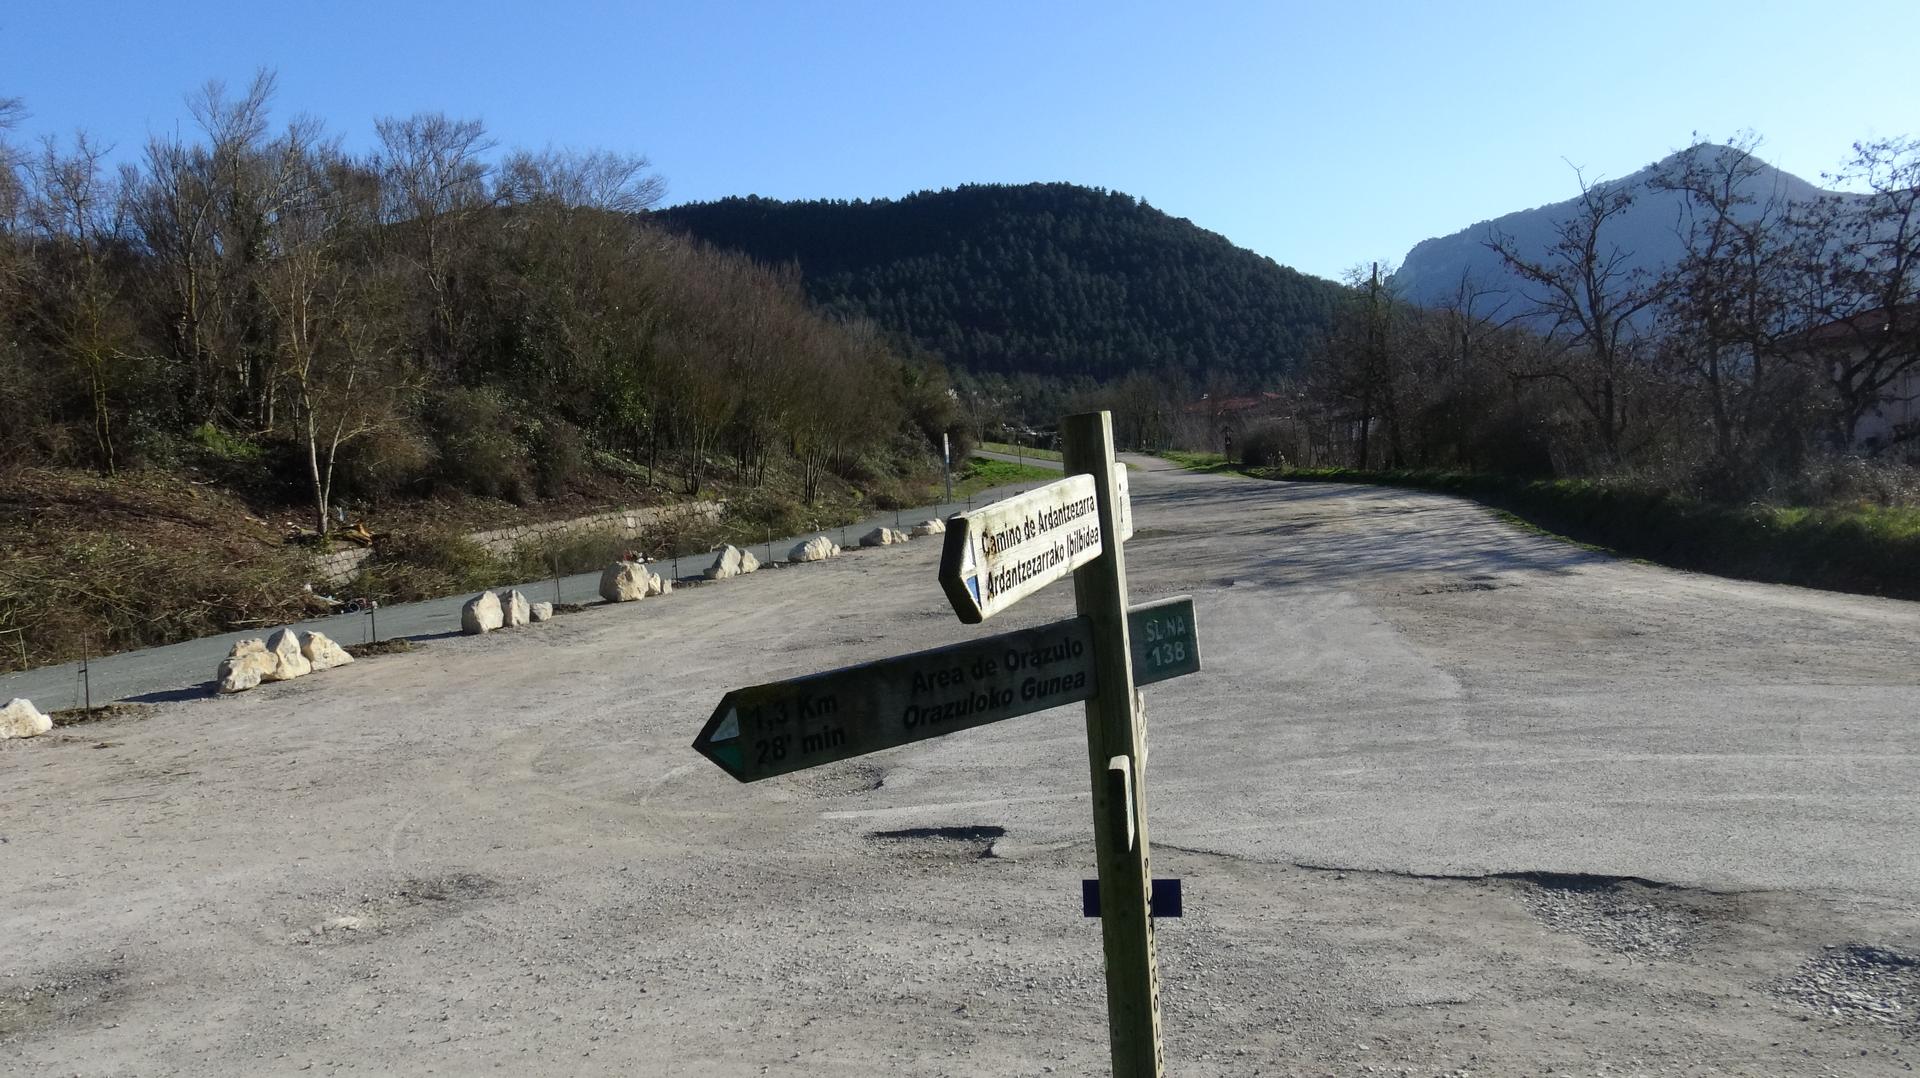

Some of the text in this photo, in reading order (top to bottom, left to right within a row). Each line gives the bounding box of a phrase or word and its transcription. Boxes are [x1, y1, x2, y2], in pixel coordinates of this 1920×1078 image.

[982, 495, 1095, 558] Camino de Ardantzezarra
[987, 525, 1099, 600] Ardantzezarrako Ibilbidea
[912, 637, 1083, 696] Area de Orazulo
[1152, 641, 1186, 666] 138
[752, 693, 838, 731] 1,3 Km
[903, 671, 1086, 730] Orazuloko Gunea
[755, 725, 846, 764] 28' min
